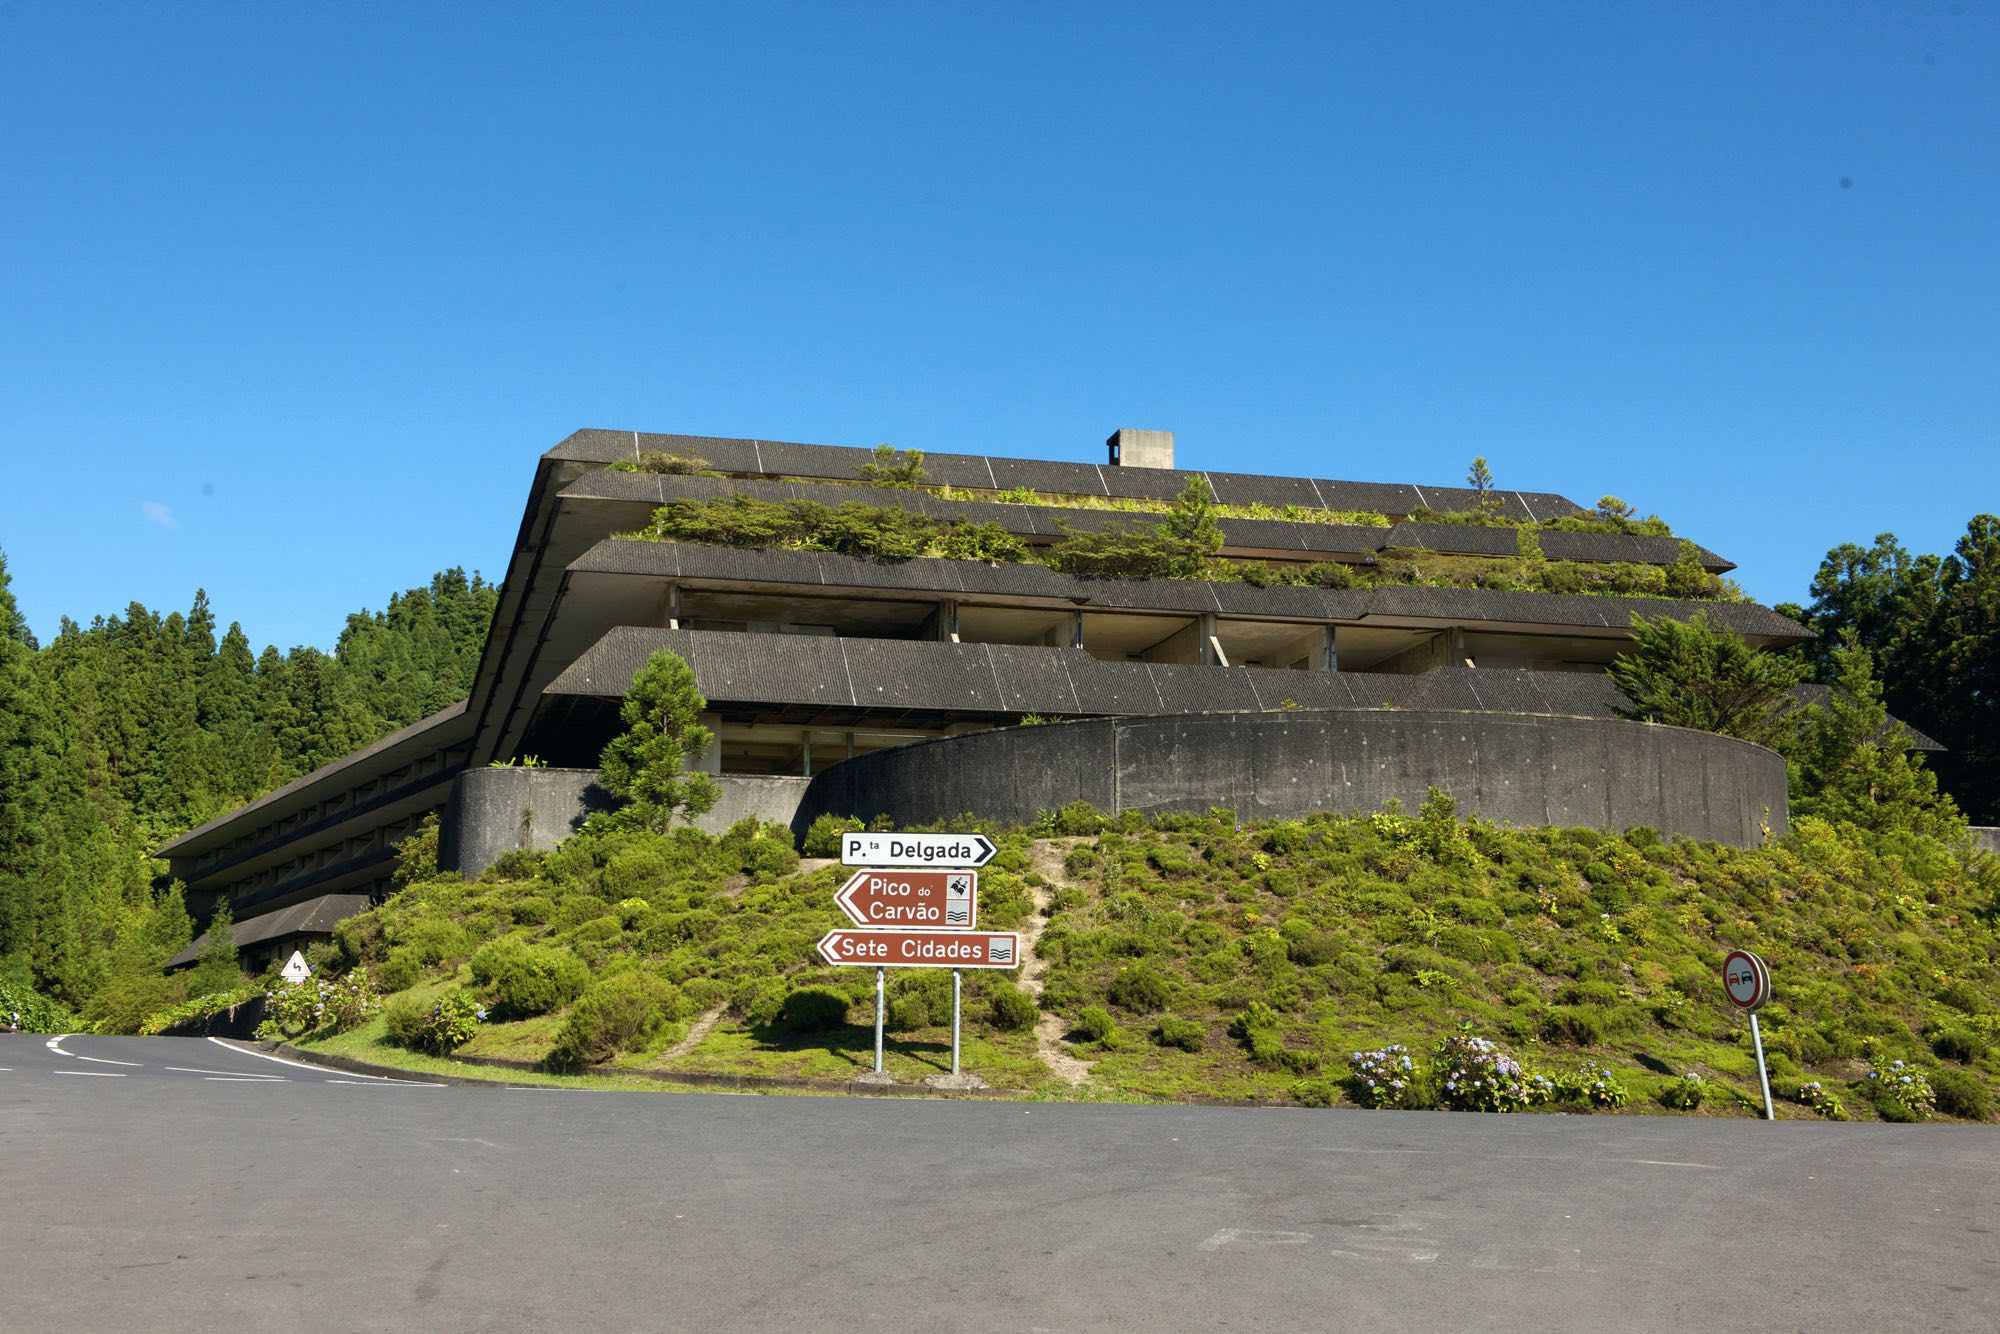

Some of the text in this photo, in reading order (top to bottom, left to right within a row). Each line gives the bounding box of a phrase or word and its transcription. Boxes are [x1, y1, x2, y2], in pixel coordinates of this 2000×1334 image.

[890, 841, 971, 861] Delgada
[870, 878, 931, 896] Pico do
[869, 901, 940, 920] Carvão
[842, 938, 982, 959] Sete Cidades
